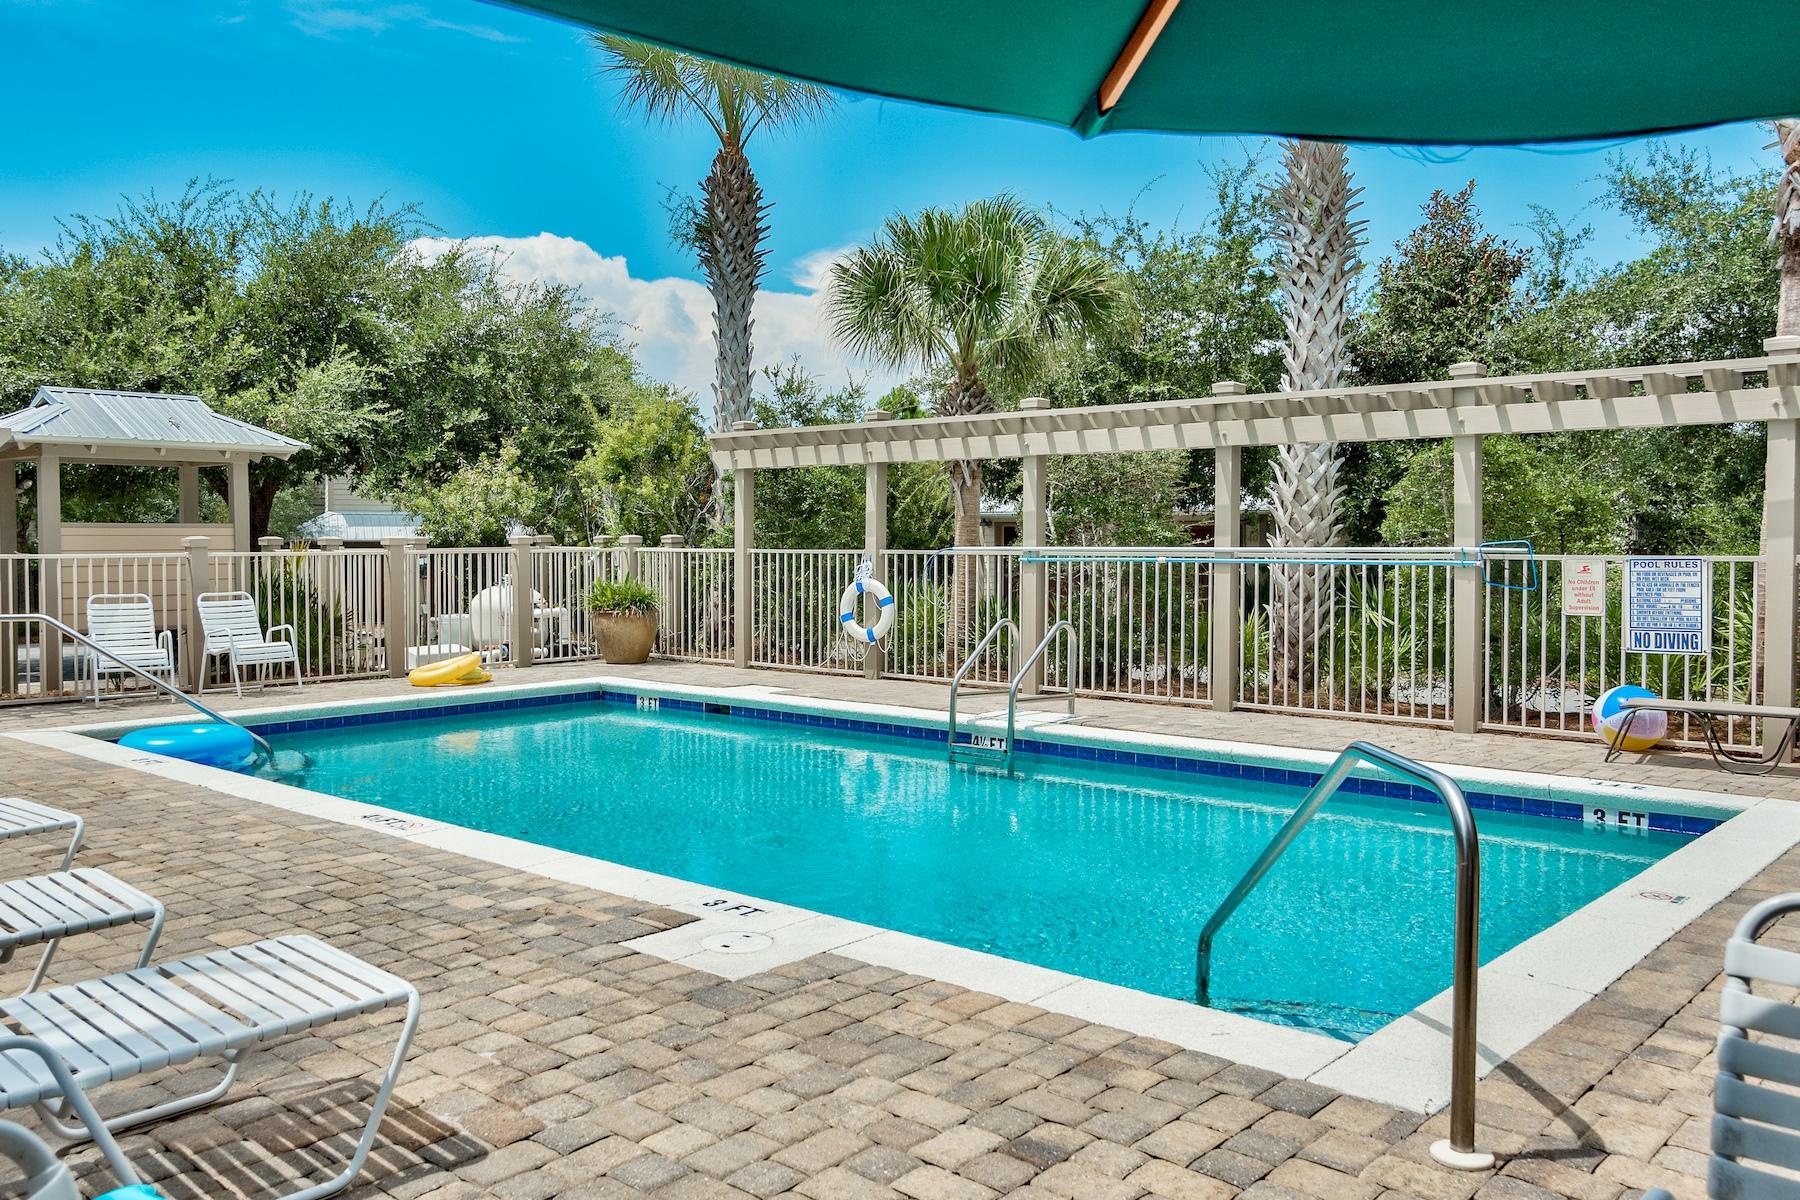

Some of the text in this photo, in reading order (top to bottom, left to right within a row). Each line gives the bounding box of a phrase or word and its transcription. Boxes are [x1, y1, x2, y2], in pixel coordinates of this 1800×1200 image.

[1633, 561, 1698, 569] POOL RULES
[1634, 632, 1699, 650] NO DIVING
[640, 696, 658, 708] 3 FT
[990, 738, 1004, 748] FT
[1593, 808, 1645, 826] 3 FT
[702, 899, 766, 916] 3 FT
